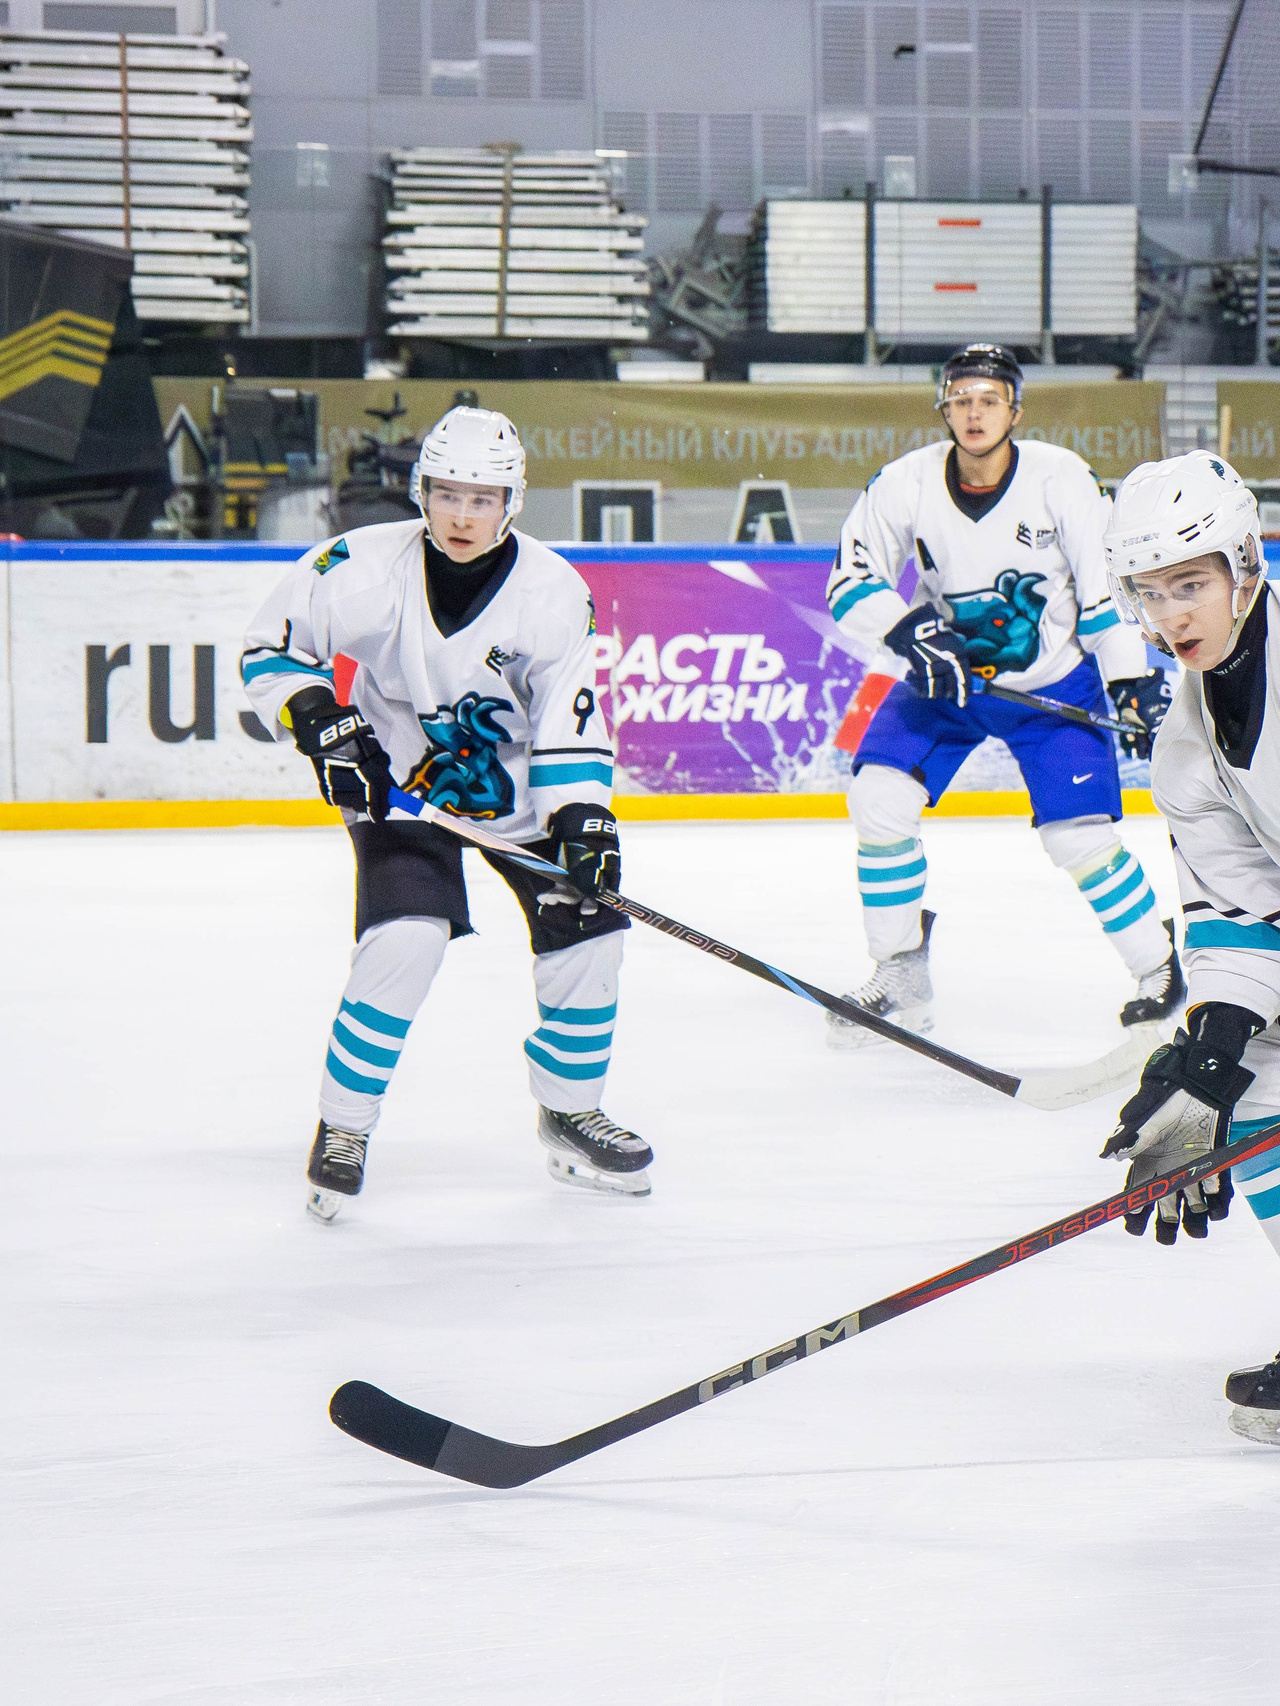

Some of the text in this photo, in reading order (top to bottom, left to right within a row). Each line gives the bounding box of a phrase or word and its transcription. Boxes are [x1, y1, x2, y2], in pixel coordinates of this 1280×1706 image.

[520, 418, 702, 460] ККЕЙНЫЙ
[710, 427, 806, 463] КЛУБ
[595, 634, 788, 684] РАСТЬ
[573, 687, 595, 737] 9
[616, 683, 809, 723] ЖИЗНИ
[998, 1179, 1170, 1268] JETSPEED
[699, 1312, 860, 1403] CCM
